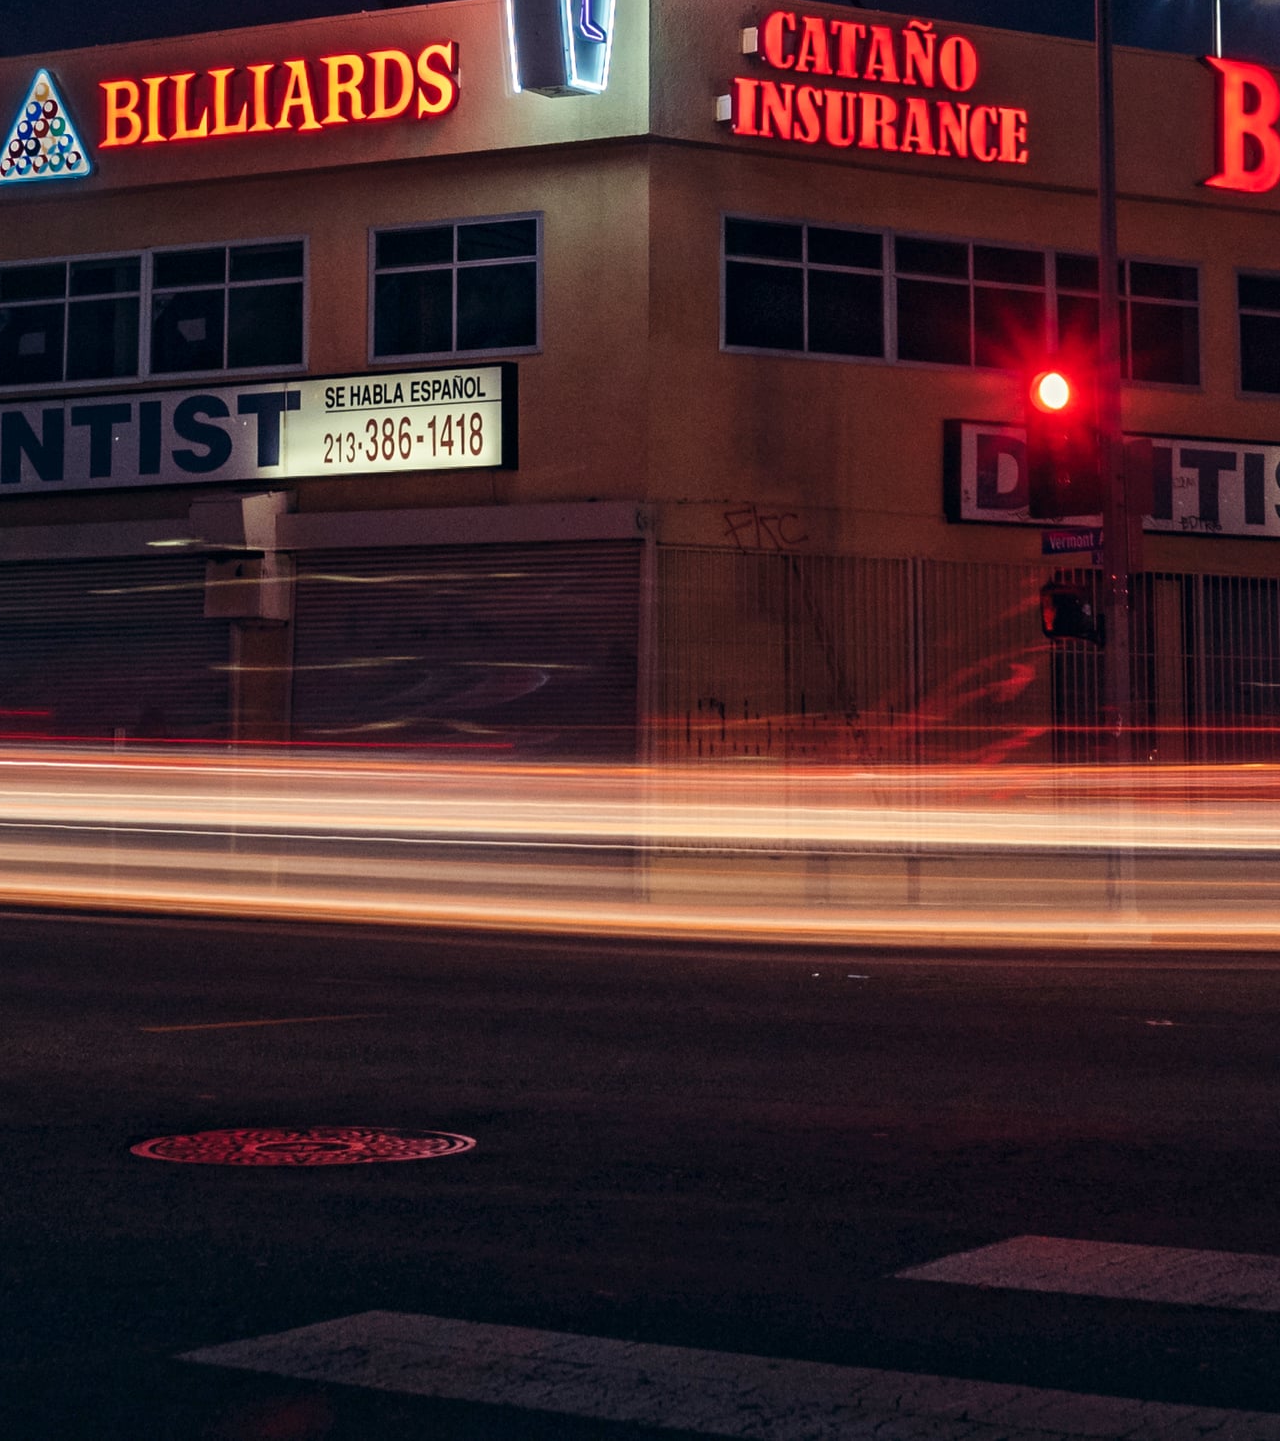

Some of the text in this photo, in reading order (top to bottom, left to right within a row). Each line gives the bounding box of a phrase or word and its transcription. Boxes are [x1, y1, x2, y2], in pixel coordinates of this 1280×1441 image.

[764, 11, 977, 92] CATAÑO
[98, 40, 455, 149] BILLIARDS
[733, 77, 1029, 164] INSURANCE
[325, 374, 486, 409] SE HABLA ESPAÑOL
[1049, 532, 1094, 550] Vermont
